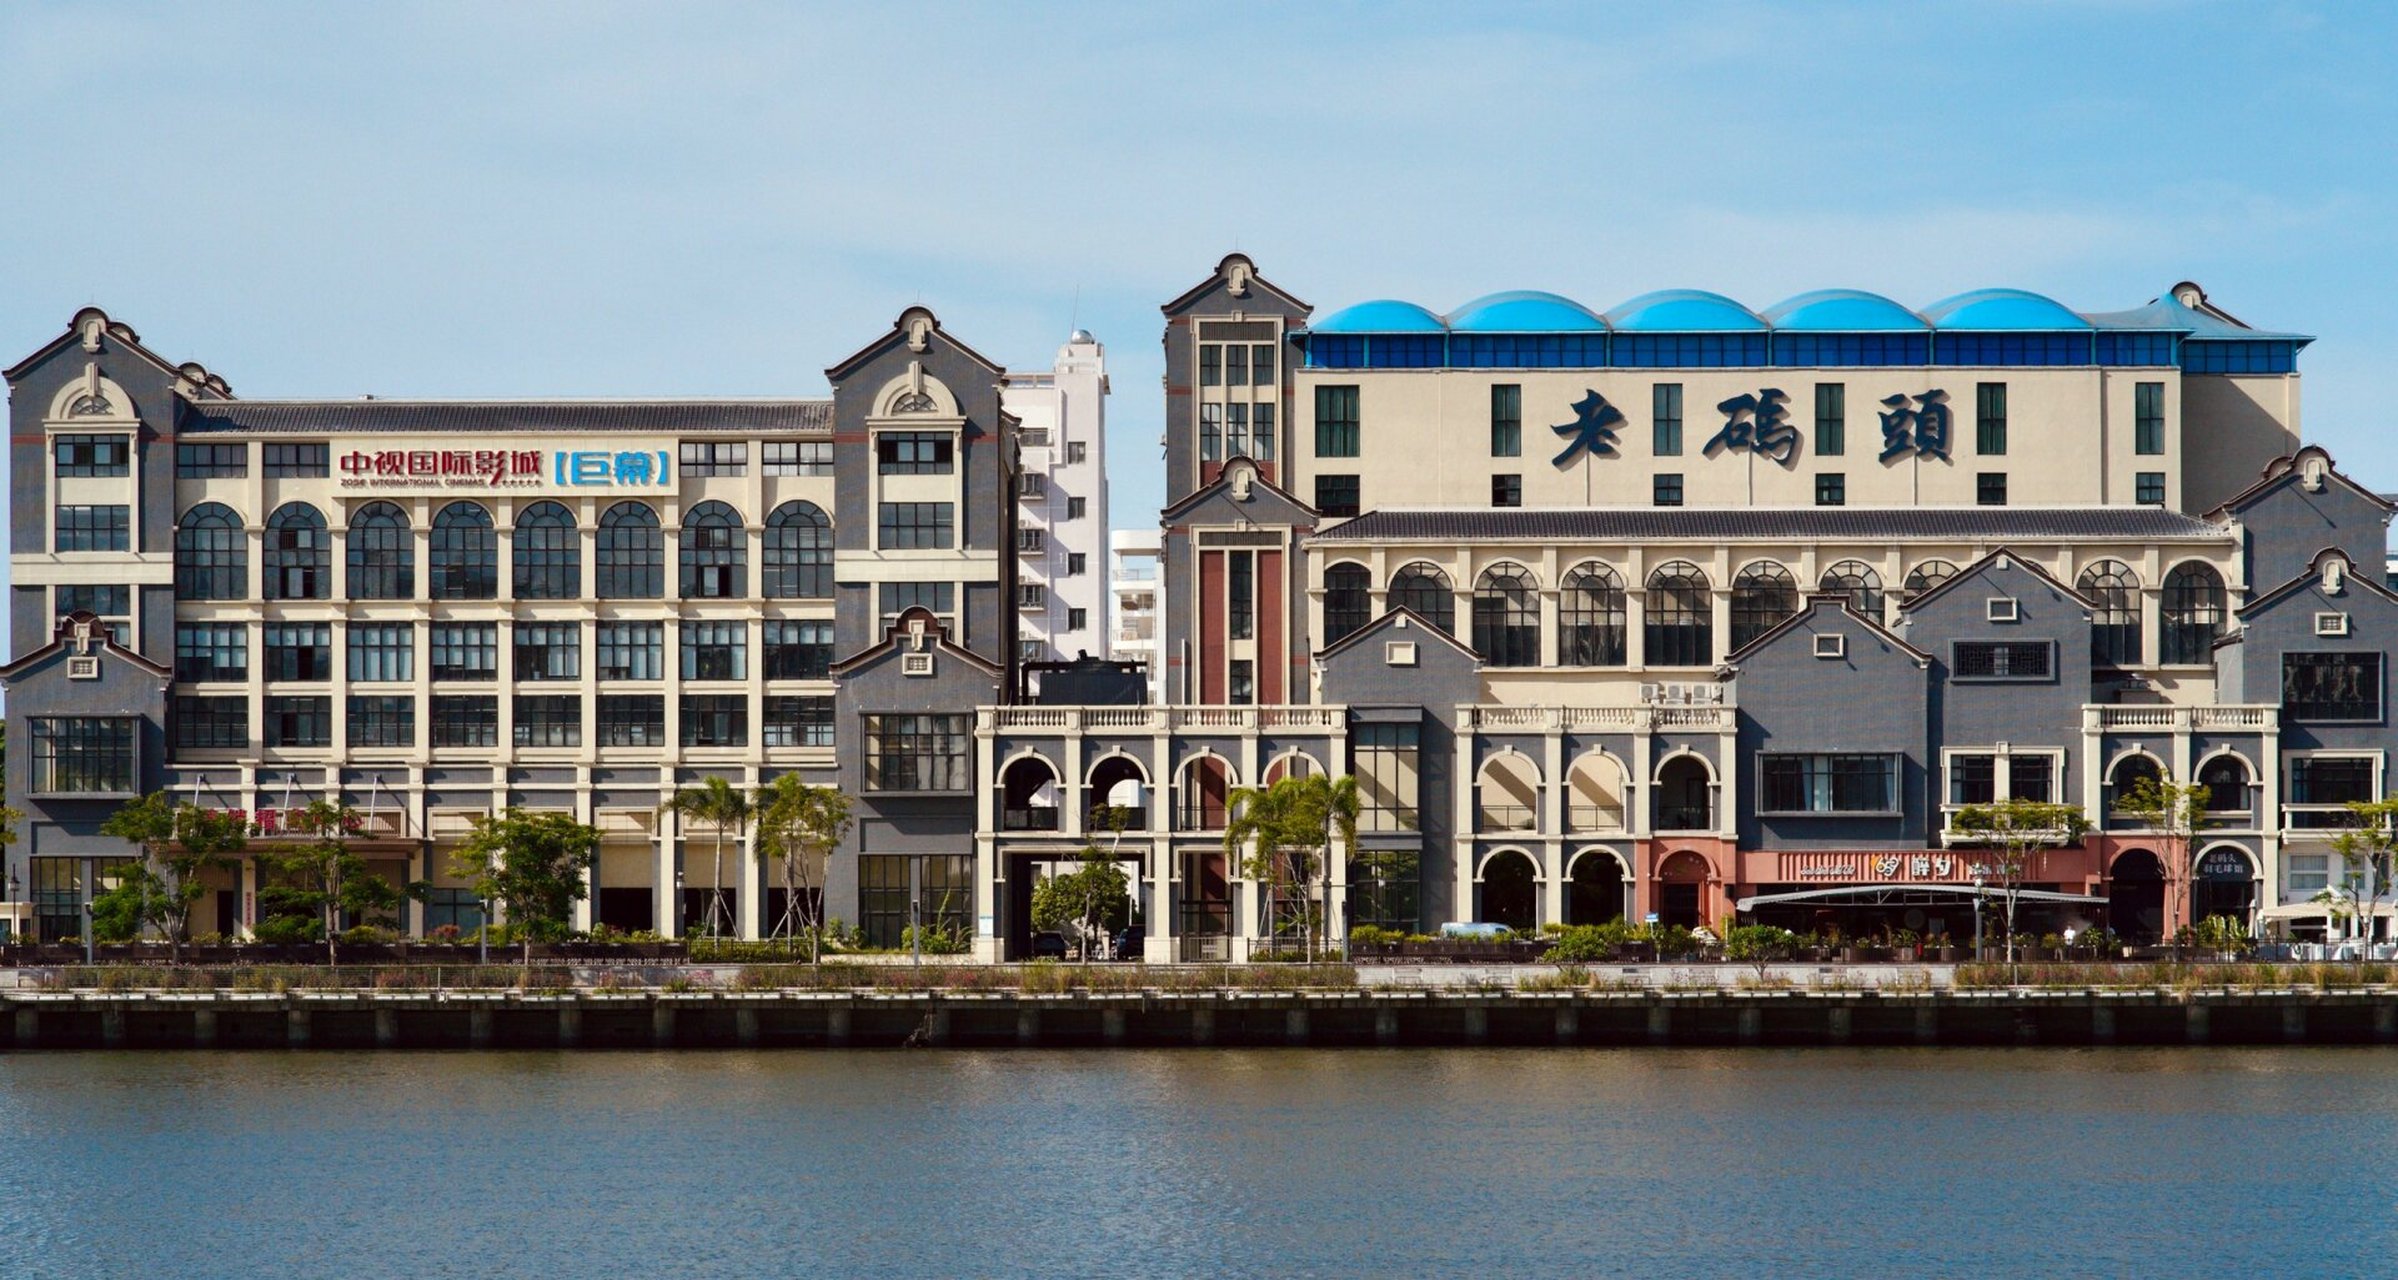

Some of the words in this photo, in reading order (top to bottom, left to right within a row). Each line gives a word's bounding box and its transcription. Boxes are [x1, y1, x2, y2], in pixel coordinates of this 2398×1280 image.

[1550, 387, 1955, 472] 老碼頭
[340, 451, 541, 486] 中视国际影城
[369, 478, 441, 487] INTERNATIONAL
[445, 478, 485, 487] CINEMAS
